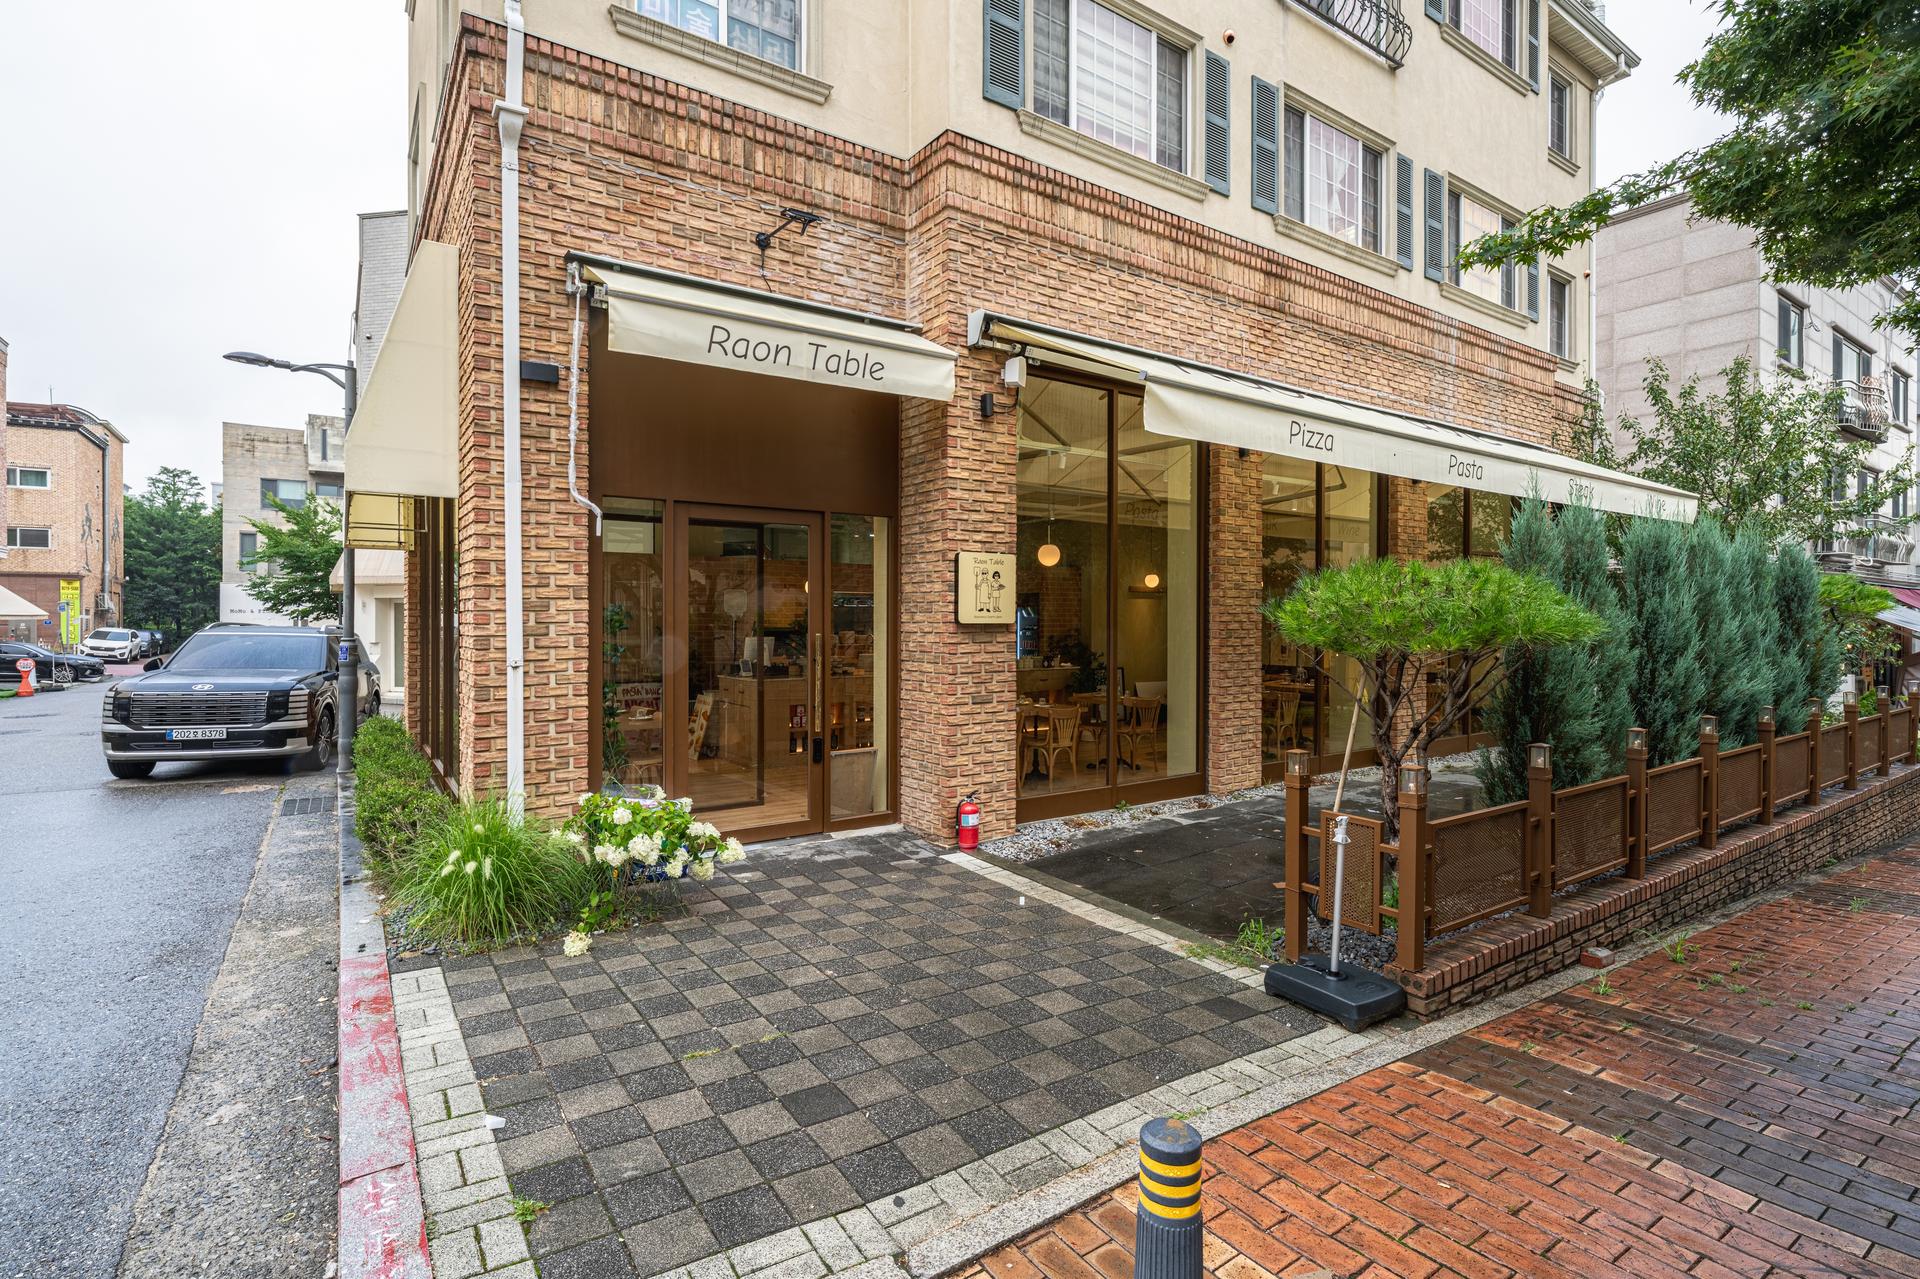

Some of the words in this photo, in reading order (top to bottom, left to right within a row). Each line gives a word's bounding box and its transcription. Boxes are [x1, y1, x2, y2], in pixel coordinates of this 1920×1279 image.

[707, 324, 792, 367] Raon
[808, 342, 885, 381] Table
[1289, 420, 1334, 452] Pizza
[1448, 454, 1484, 480] Pasta
[174, 730, 199, 739] 202호
[201, 729, 225, 738] 8378
